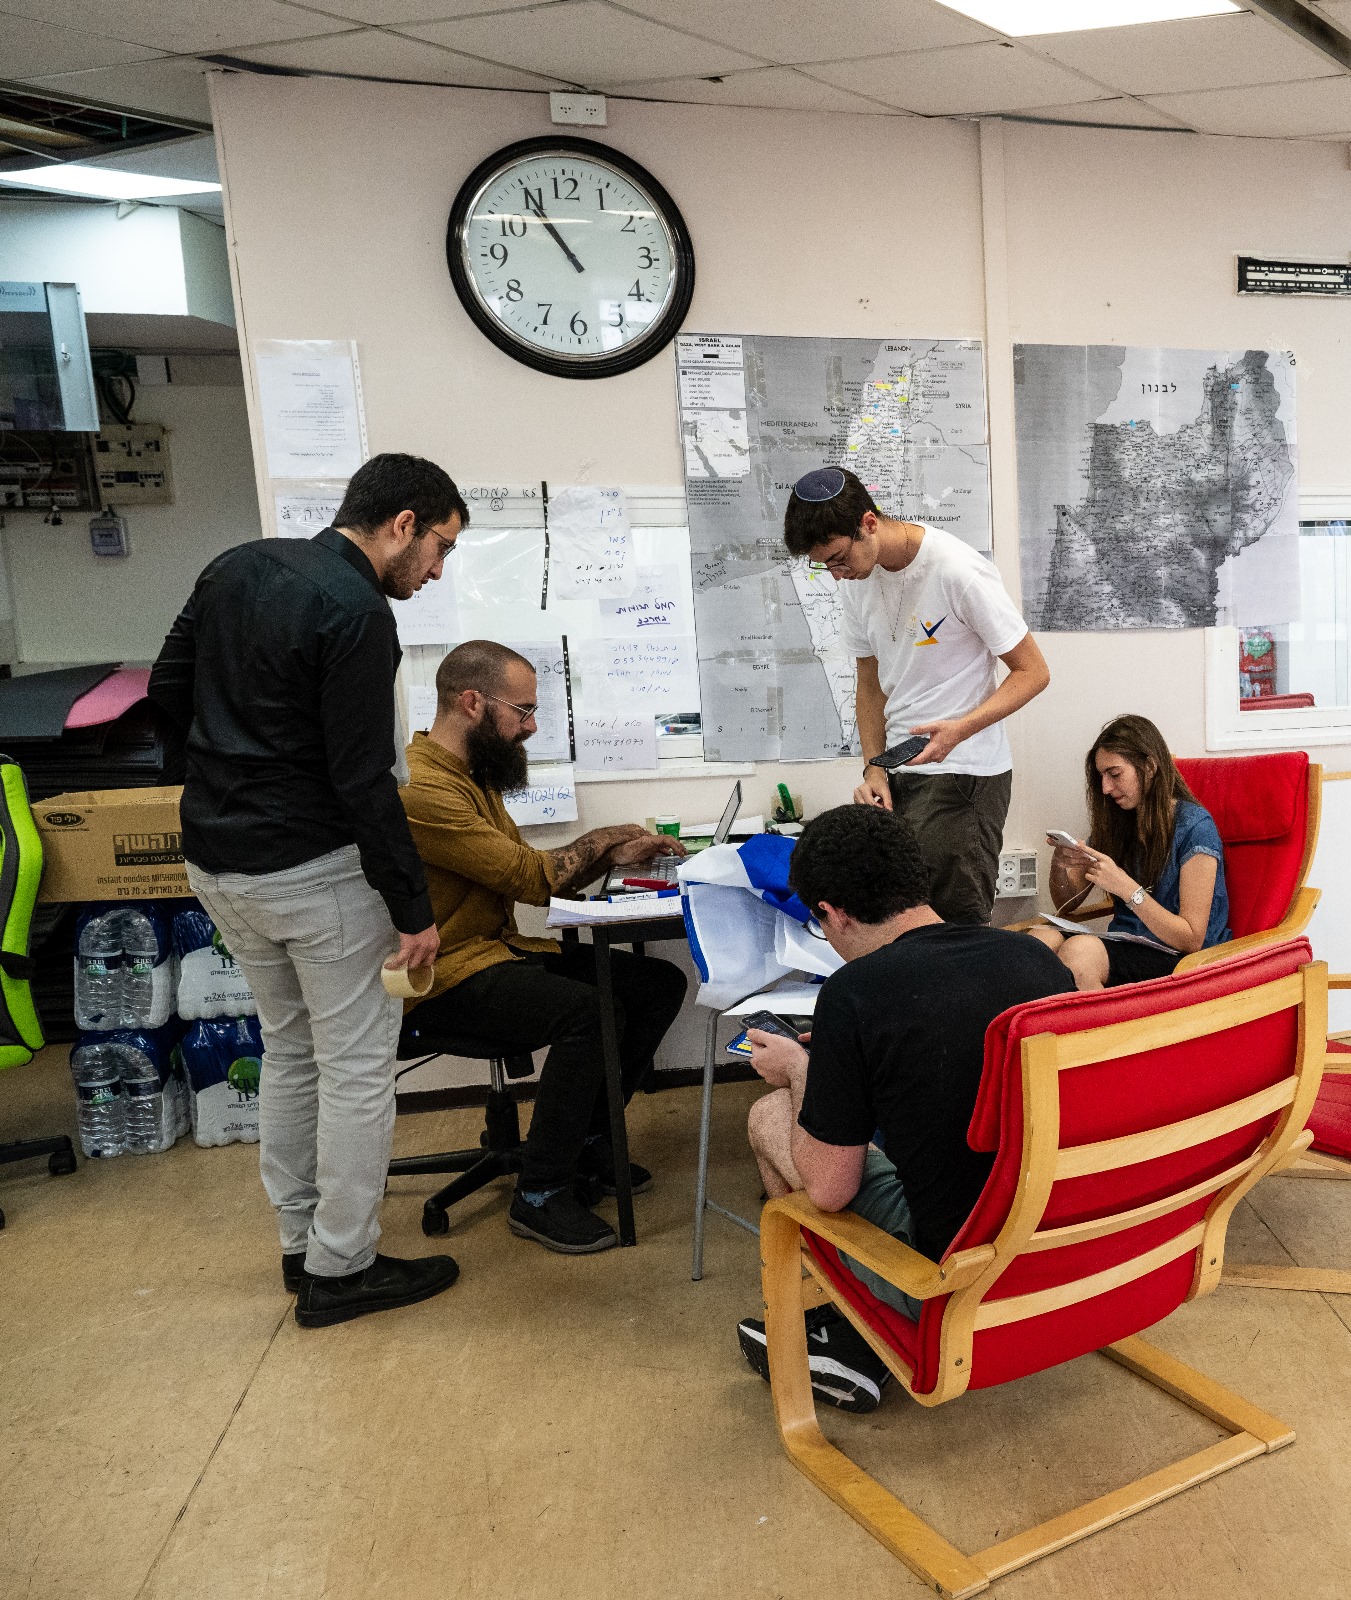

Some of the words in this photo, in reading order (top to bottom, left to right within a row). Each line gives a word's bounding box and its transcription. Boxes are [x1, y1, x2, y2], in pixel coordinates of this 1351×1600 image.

[551, 177, 580, 201] 12
[596, 188, 607, 210] 1
[500, 214, 527, 238] 10
[620, 211, 636, 233] 2
[490, 243, 508, 268] 9
[637, 247, 654, 269] 3
[506, 279, 524, 302] 8
[627, 278, 644, 302] 4
[538, 303, 552, 326] 7
[570, 311, 588, 336] 6
[608, 304, 624, 328] 5
[1141, 382, 1177, 394] לבנון
[97, 874, 122, 884] instant
[123, 874, 150, 883] noodles
